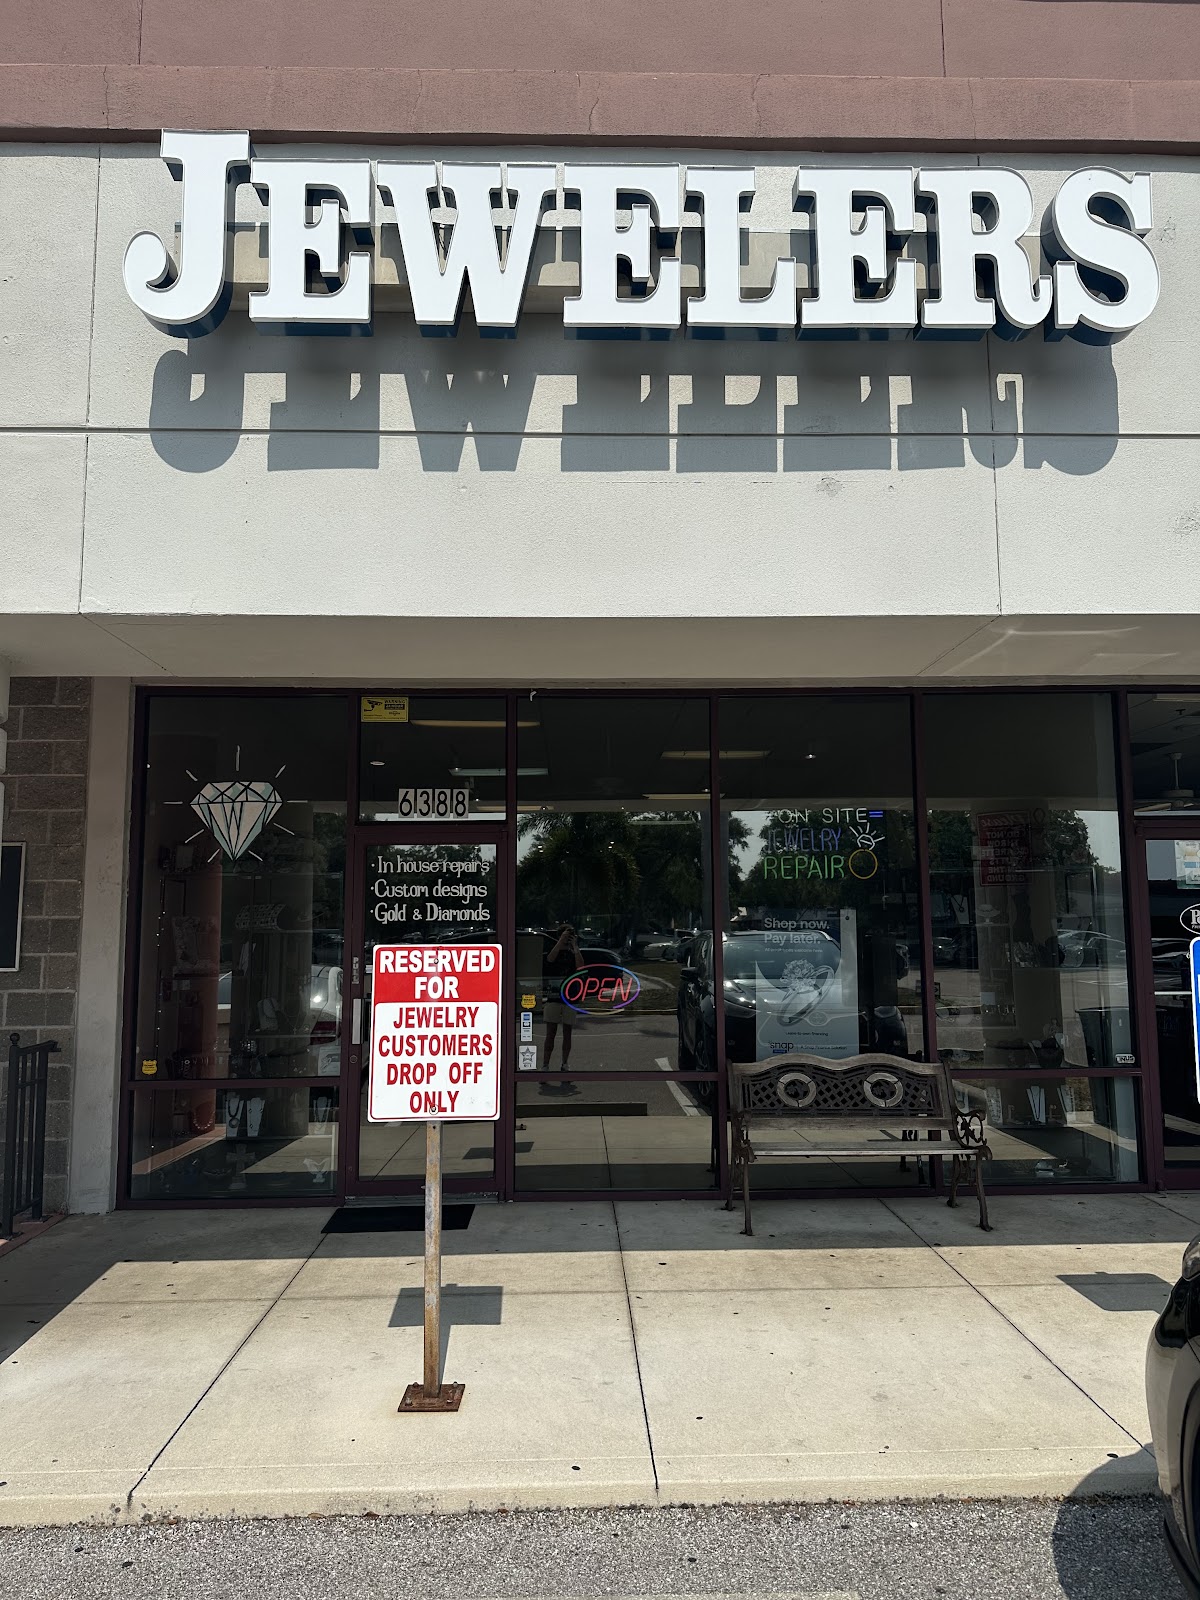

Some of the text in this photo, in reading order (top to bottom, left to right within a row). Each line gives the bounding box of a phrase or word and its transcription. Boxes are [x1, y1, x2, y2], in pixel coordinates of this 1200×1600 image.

[122, 128, 1161, 338] JEWELERS
[399, 789, 467, 818] 6388
[778, 807, 868, 823] ON SITE
[764, 827, 842, 853] JEWELRY
[377, 855, 490, 878] In house repairs
[764, 855, 845, 879] REPAIR
[374, 878, 488, 904] Custom designs
[374, 902, 491, 924] Gold & Diamonds
[764, 917, 830, 932] Shop now.
[764, 932, 821, 947] Pay later.
[379, 949, 495, 973] RESERVED
[415, 976, 459, 999] FOR
[565, 977, 633, 1002] OPEN
[393, 1006, 479, 1028] JEWELRY
[378, 1034, 493, 1057] CUSTOMERS
[770, 1041, 794, 1054] snap
[387, 1062, 483, 1085] DROP OFF
[410, 1091, 459, 1113] ONLY
